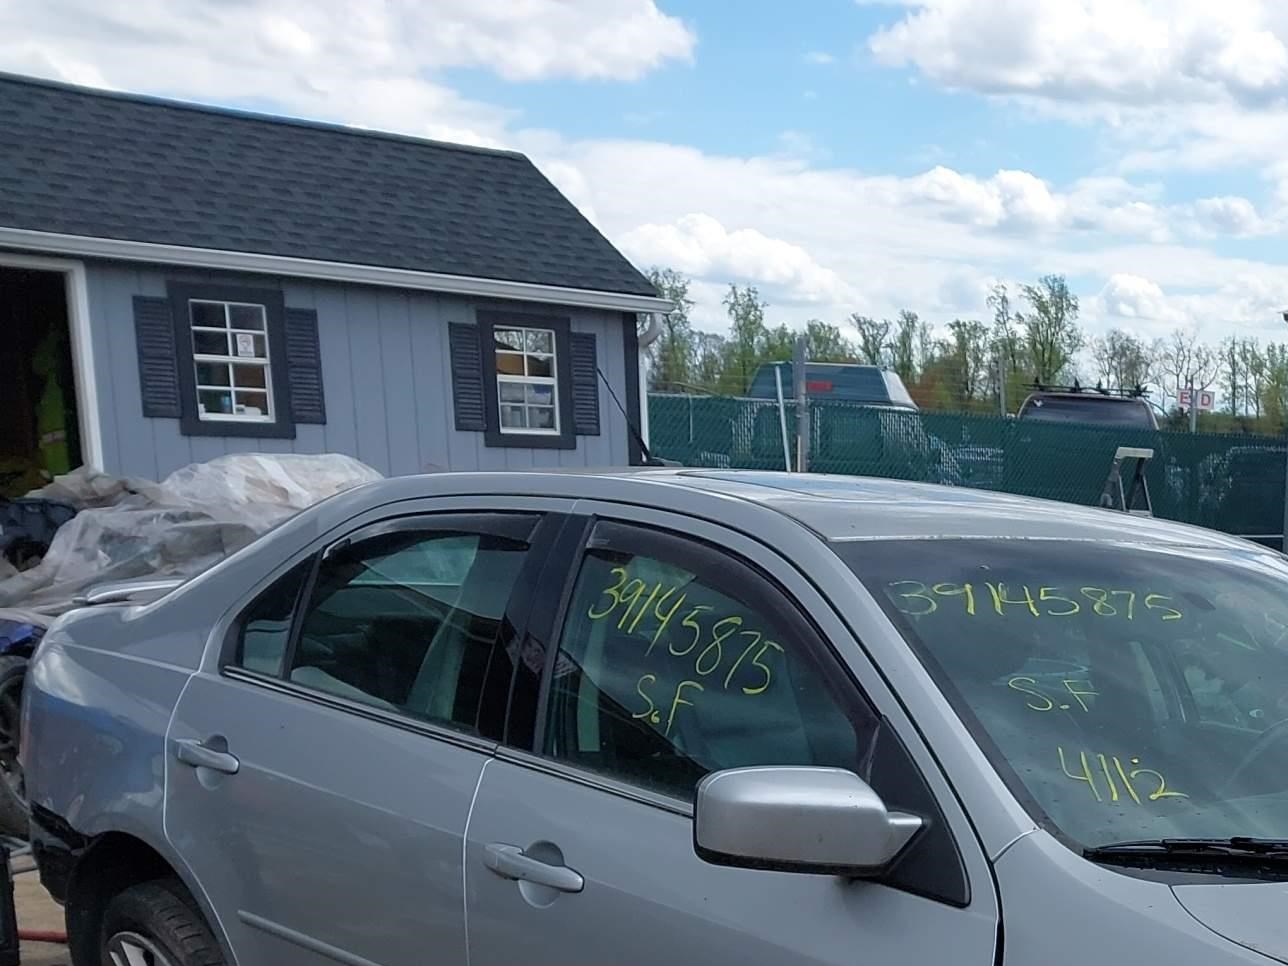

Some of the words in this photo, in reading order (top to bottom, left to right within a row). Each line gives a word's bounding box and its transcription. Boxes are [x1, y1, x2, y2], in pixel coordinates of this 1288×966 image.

[1201, 394, 1211, 406] D
[888, 580, 1182, 620] 39145875
[588, 567, 784, 694] 39145875
